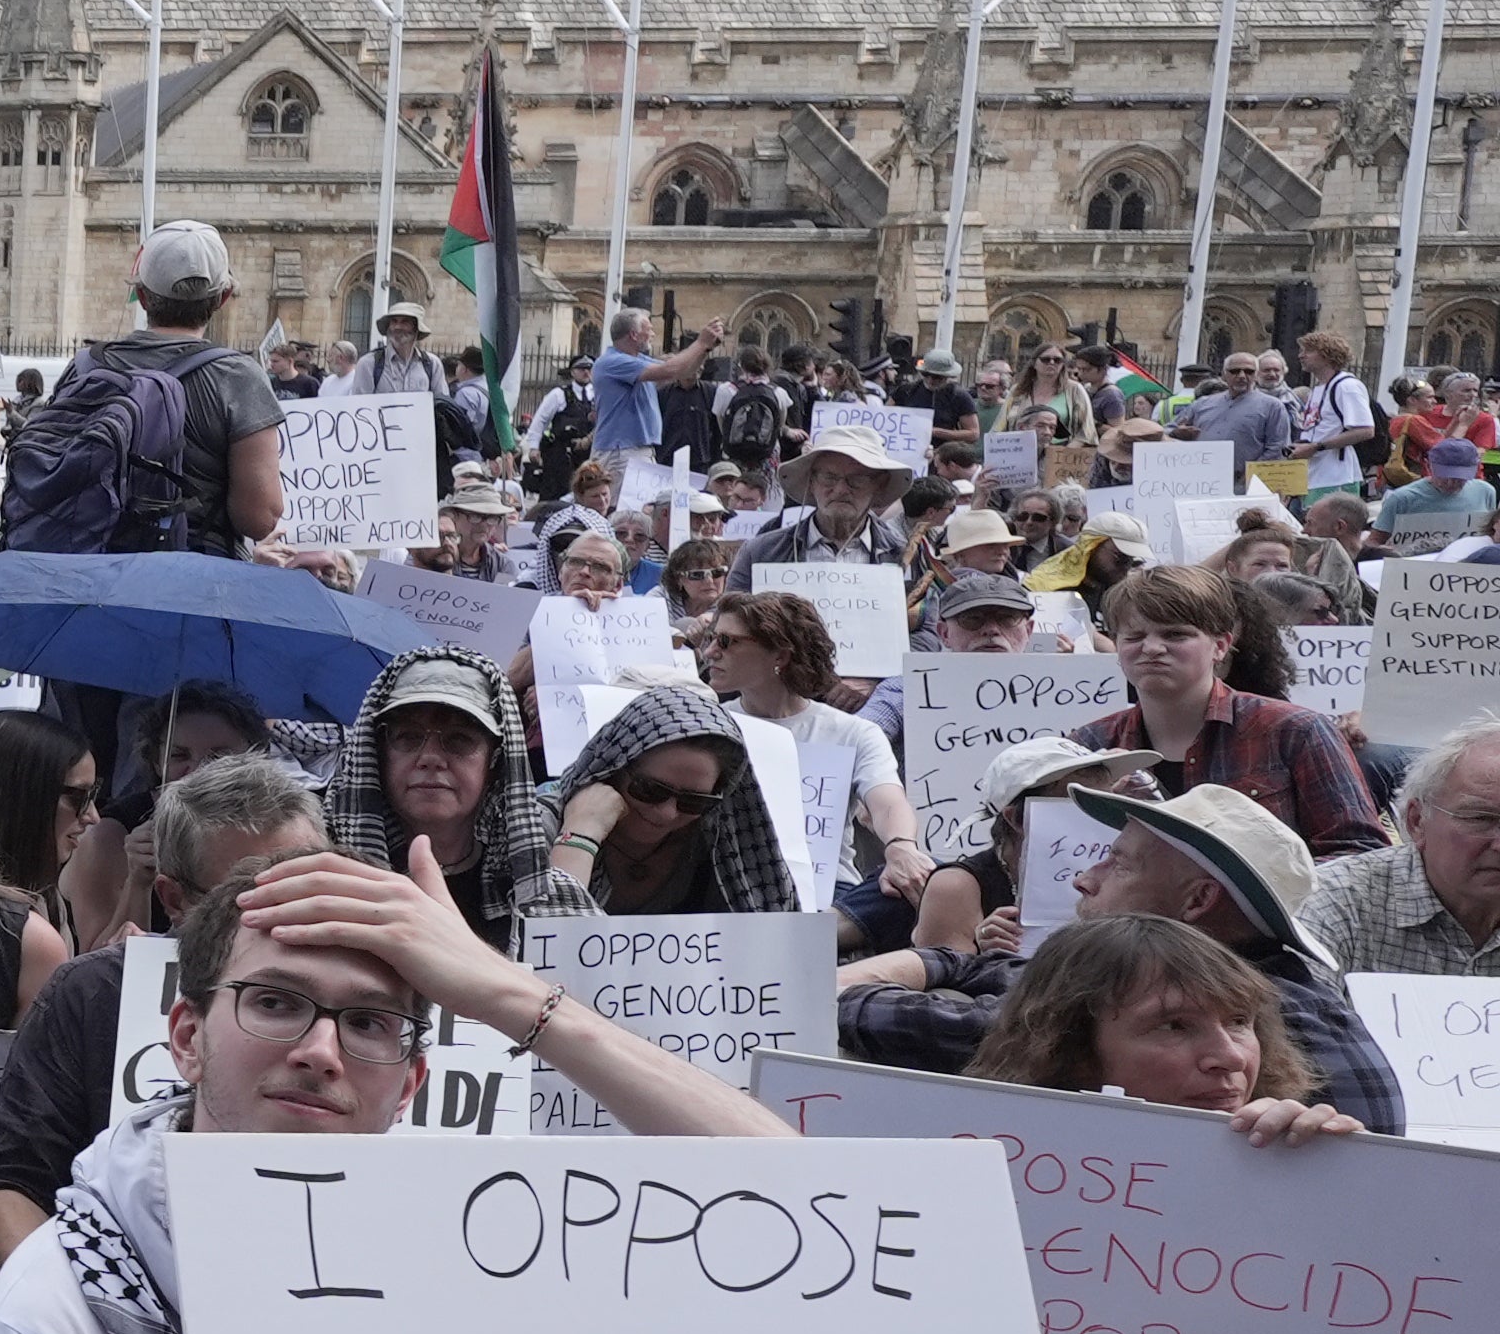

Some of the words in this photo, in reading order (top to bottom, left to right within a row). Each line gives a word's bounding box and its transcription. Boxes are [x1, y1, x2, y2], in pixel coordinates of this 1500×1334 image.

[835, 407, 912, 437] OPPOSE
[1138, 480, 1221, 499] GENOCIDE
[367, 518, 435, 544] ACTION
[780, 568, 862, 586] OPPOSE
[397, 582, 492, 616] OPPOSE
[912, 668, 949, 710] I
[973, 672, 1122, 712] OPPOSE
[531, 932, 558, 969] I
[576, 932, 723, 969] OPPOSE
[592, 976, 783, 1018] GENOCIDE
[253, 1164, 386, 1301] I
[461, 1166, 922, 1308] OPPOSE
